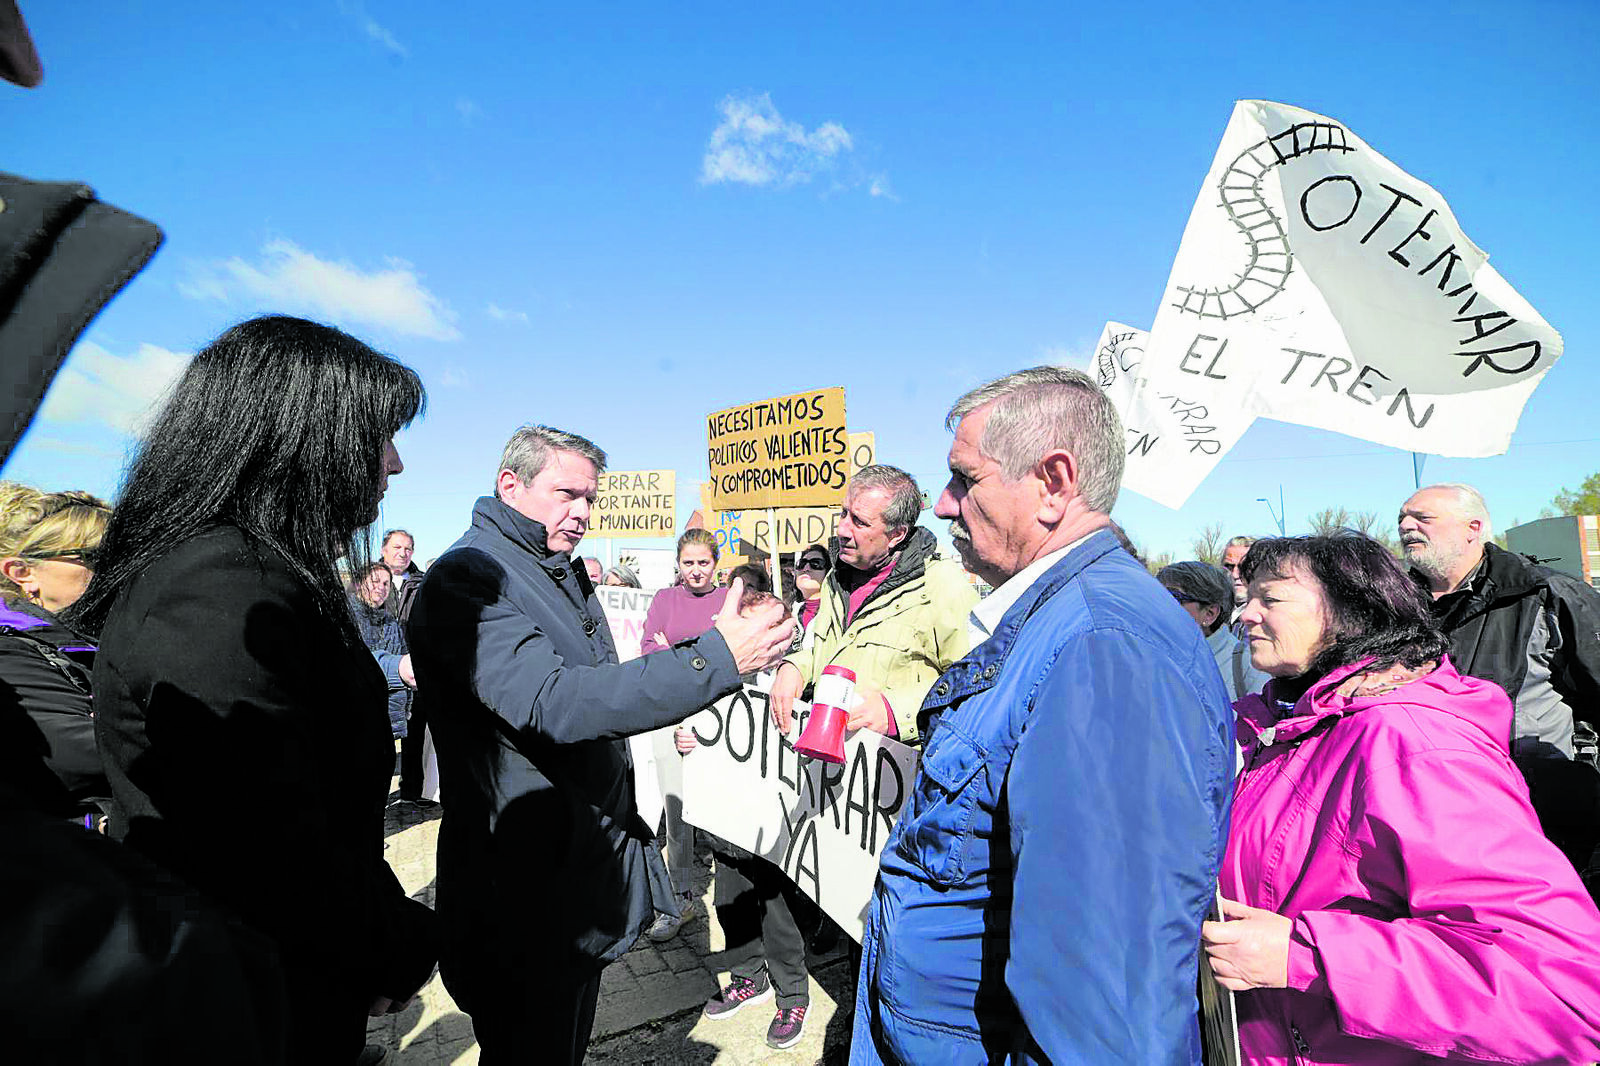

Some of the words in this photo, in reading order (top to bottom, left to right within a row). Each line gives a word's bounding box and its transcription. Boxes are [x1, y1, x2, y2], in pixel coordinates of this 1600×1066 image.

[1180, 333, 1229, 380] EL
[1280, 347, 1435, 429] TREN
[709, 395, 824, 441] NECESITAMOS
[709, 440, 757, 470] POLITICOS
[764, 426, 846, 461] VALIENTES
[711, 475, 718, 498] Y
[722, 459, 846, 496] COMPROMETIDOS
[600, 514, 672, 531] MUNICIPIO
[601, 589, 653, 611] ENT
[779, 793, 821, 905] YA
